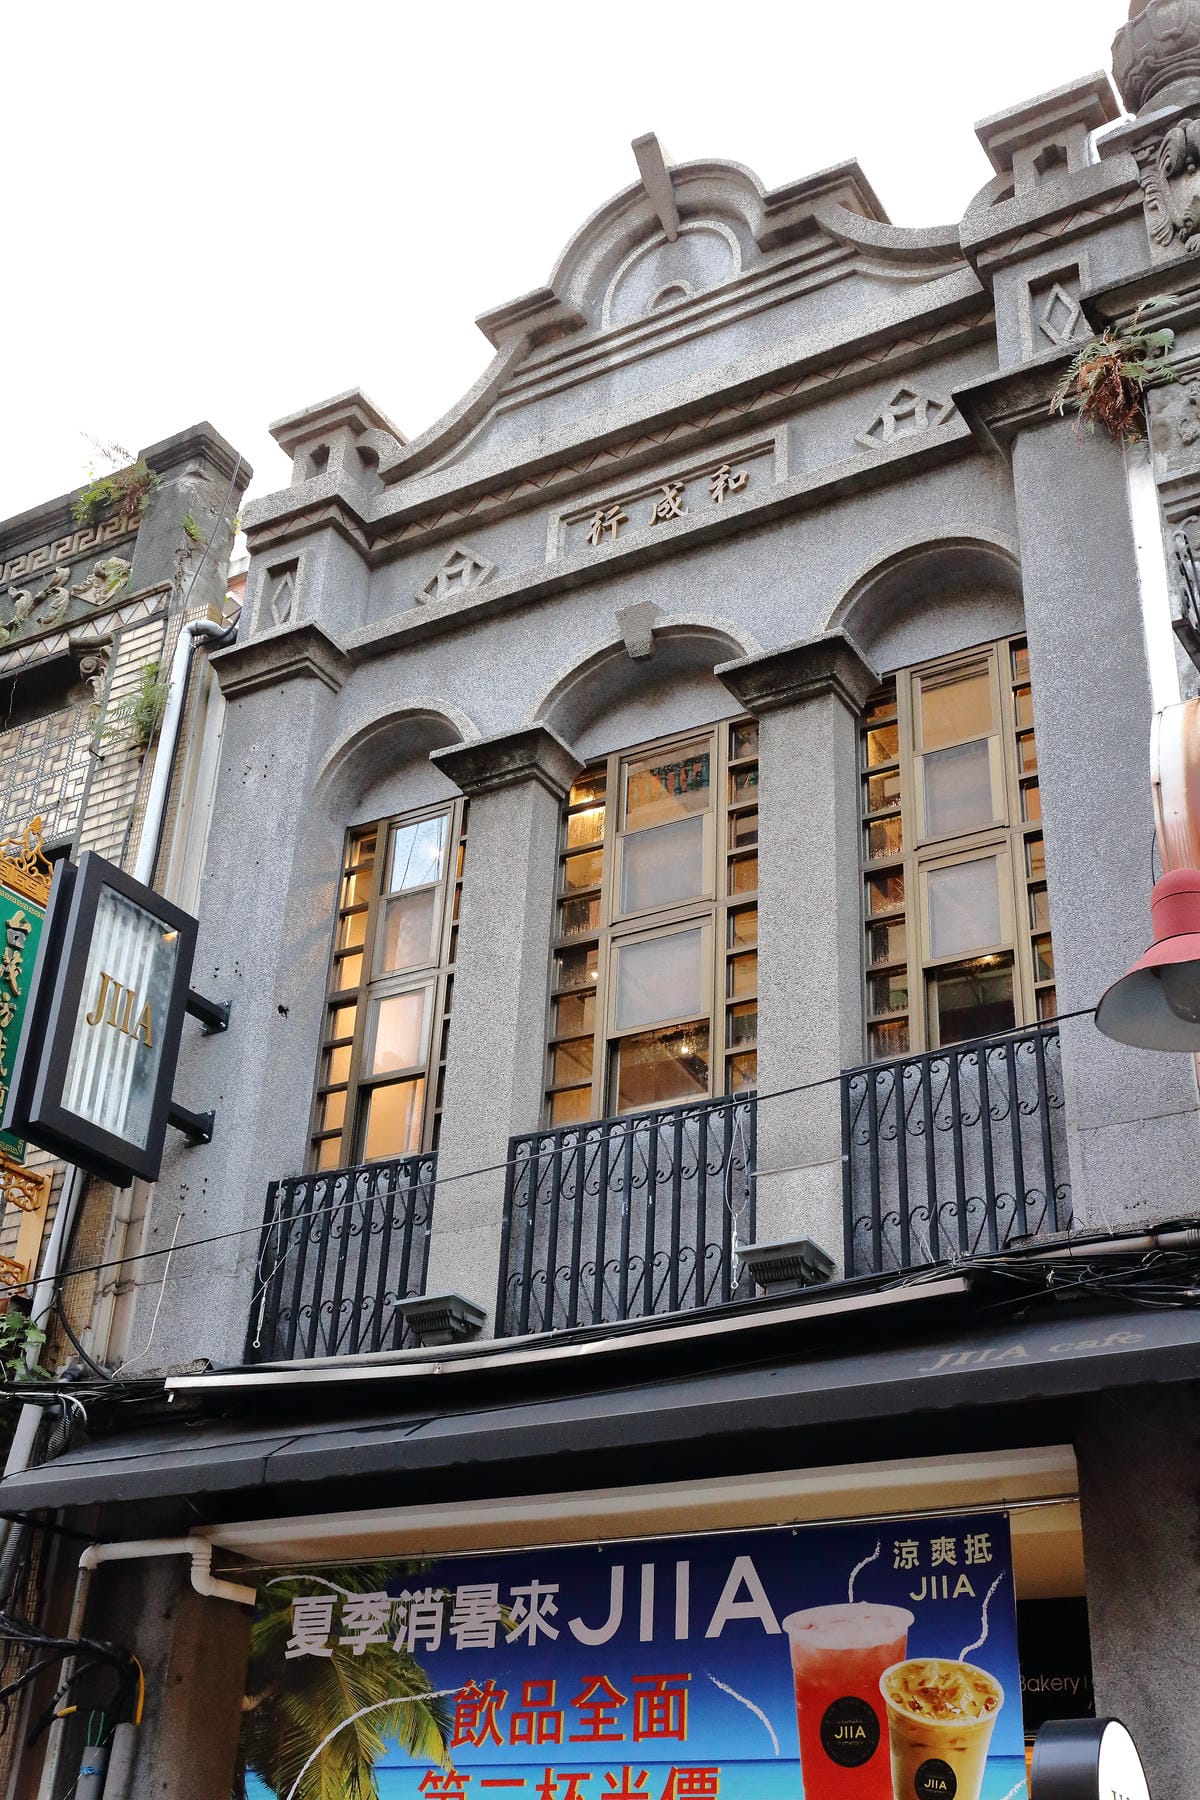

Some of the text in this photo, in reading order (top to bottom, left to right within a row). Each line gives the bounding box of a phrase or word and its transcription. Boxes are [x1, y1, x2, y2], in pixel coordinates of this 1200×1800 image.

[87, 971, 153, 1049] JIIA
[919, 1331, 1145, 1372] JIIA cafe
[893, 1533, 993, 1570] 涼爽抵
[909, 1573, 976, 1601] JIIA
[450, 1673, 692, 1748] 飲品全面
[834, 1725, 866, 1739] JIIA
[924, 1778, 947, 1790] JIIA
